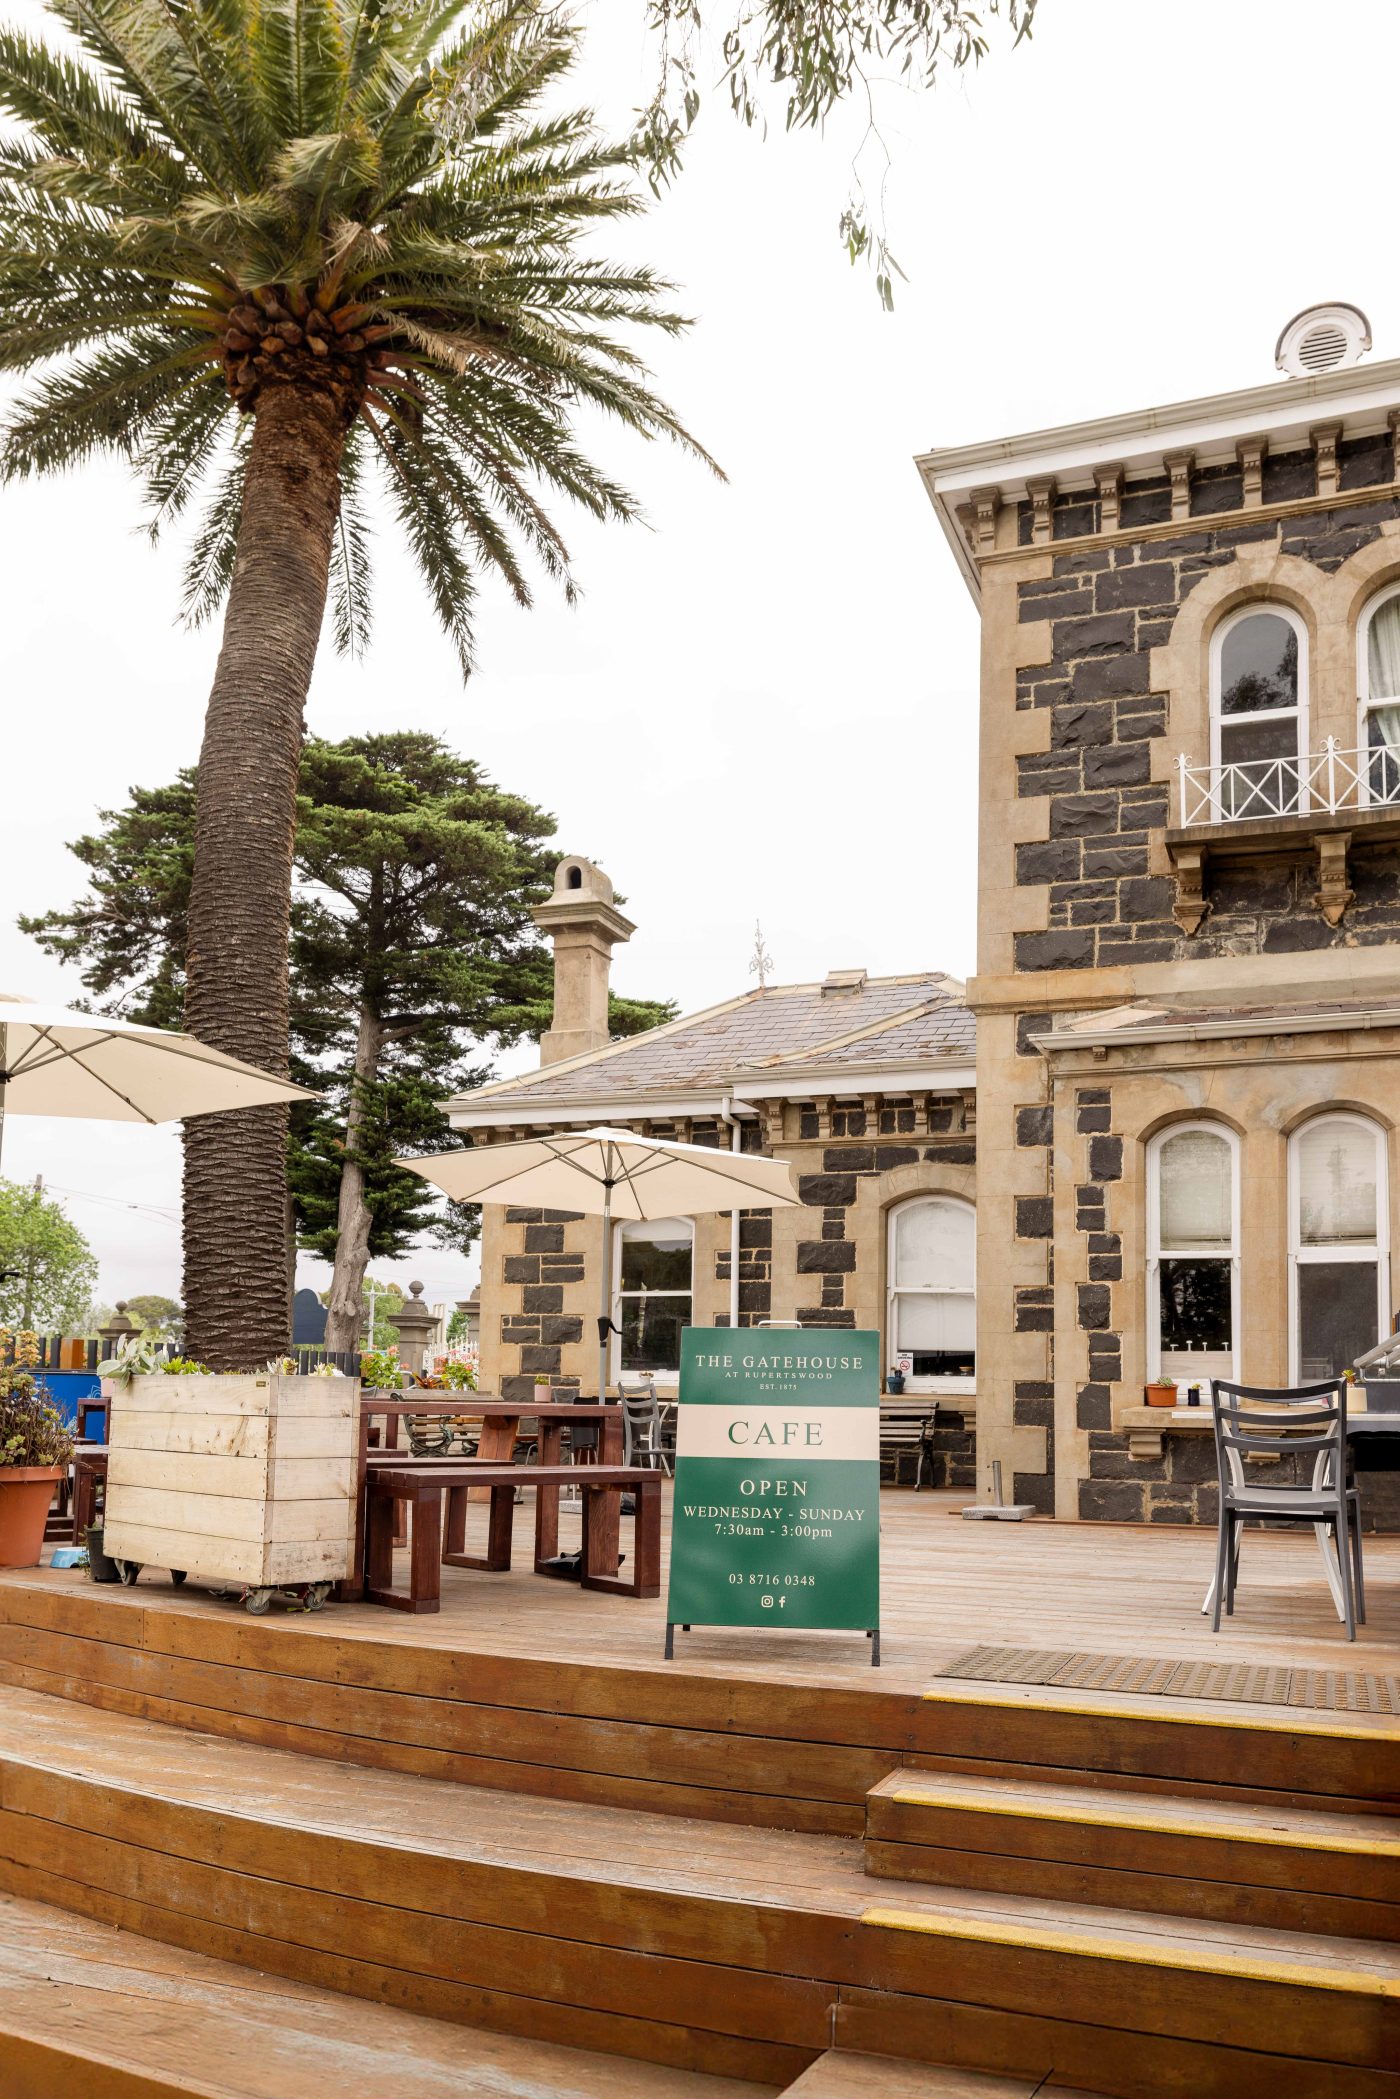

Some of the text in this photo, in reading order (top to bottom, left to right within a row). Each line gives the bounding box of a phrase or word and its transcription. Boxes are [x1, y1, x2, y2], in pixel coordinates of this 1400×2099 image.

[695, 1355, 863, 1370] THE GATEHOUSE
[745, 1372, 833, 1380] RUPERTSWOOD
[779, 1383, 797, 1391] 1875
[728, 1421, 823, 1446] CAFE
[740, 1479, 807, 1497] OPEN
[683, 1505, 783, 1519] WEDNESDAY
[799, 1508, 865, 1521] SUNDAY
[714, 1523, 765, 1536] 7:30am
[781, 1525, 833, 1538] 3:00pm
[728, 1573, 815, 1587] 03 8716 0348
